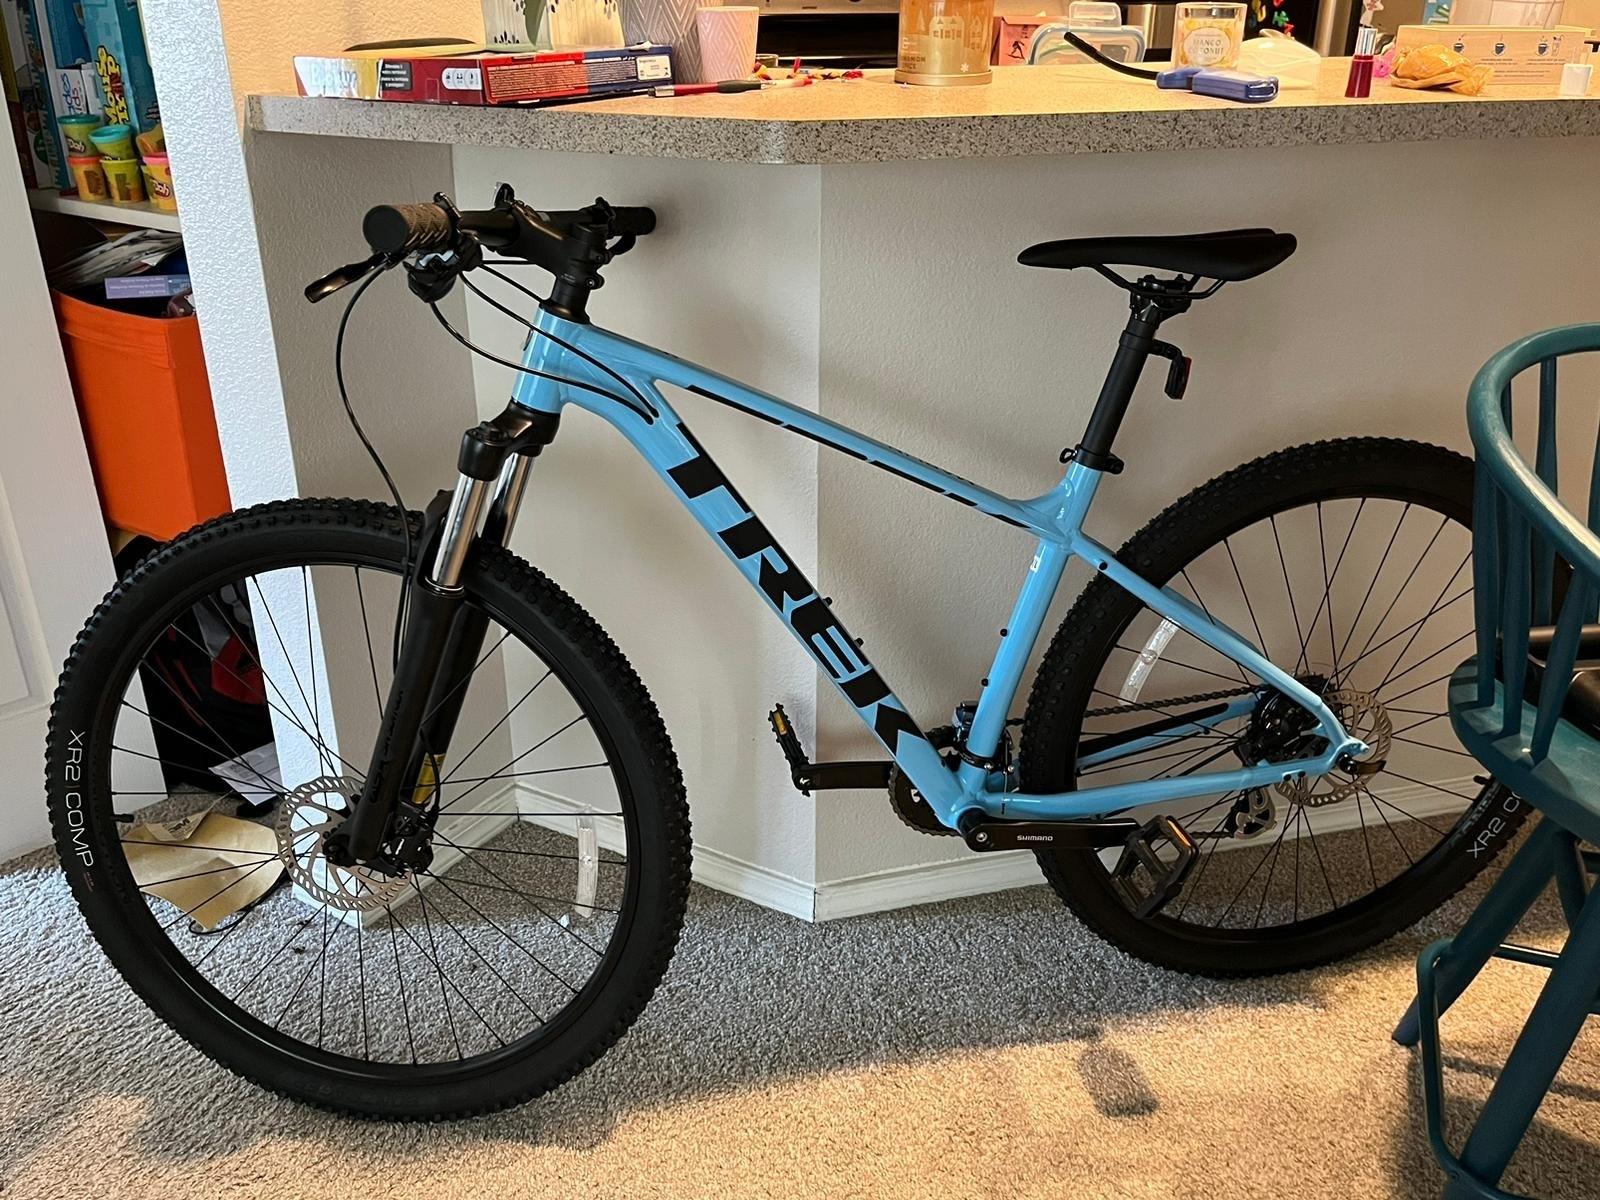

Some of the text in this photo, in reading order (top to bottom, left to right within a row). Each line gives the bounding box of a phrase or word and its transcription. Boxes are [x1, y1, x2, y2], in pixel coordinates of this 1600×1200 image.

[667, 422, 928, 756] TREK
[65, 729, 86, 781] XR2
[65, 792, 94, 867] COMP
[1016, 834, 1054, 842] SHIMANO
[1466, 816, 1506, 859] XR2
